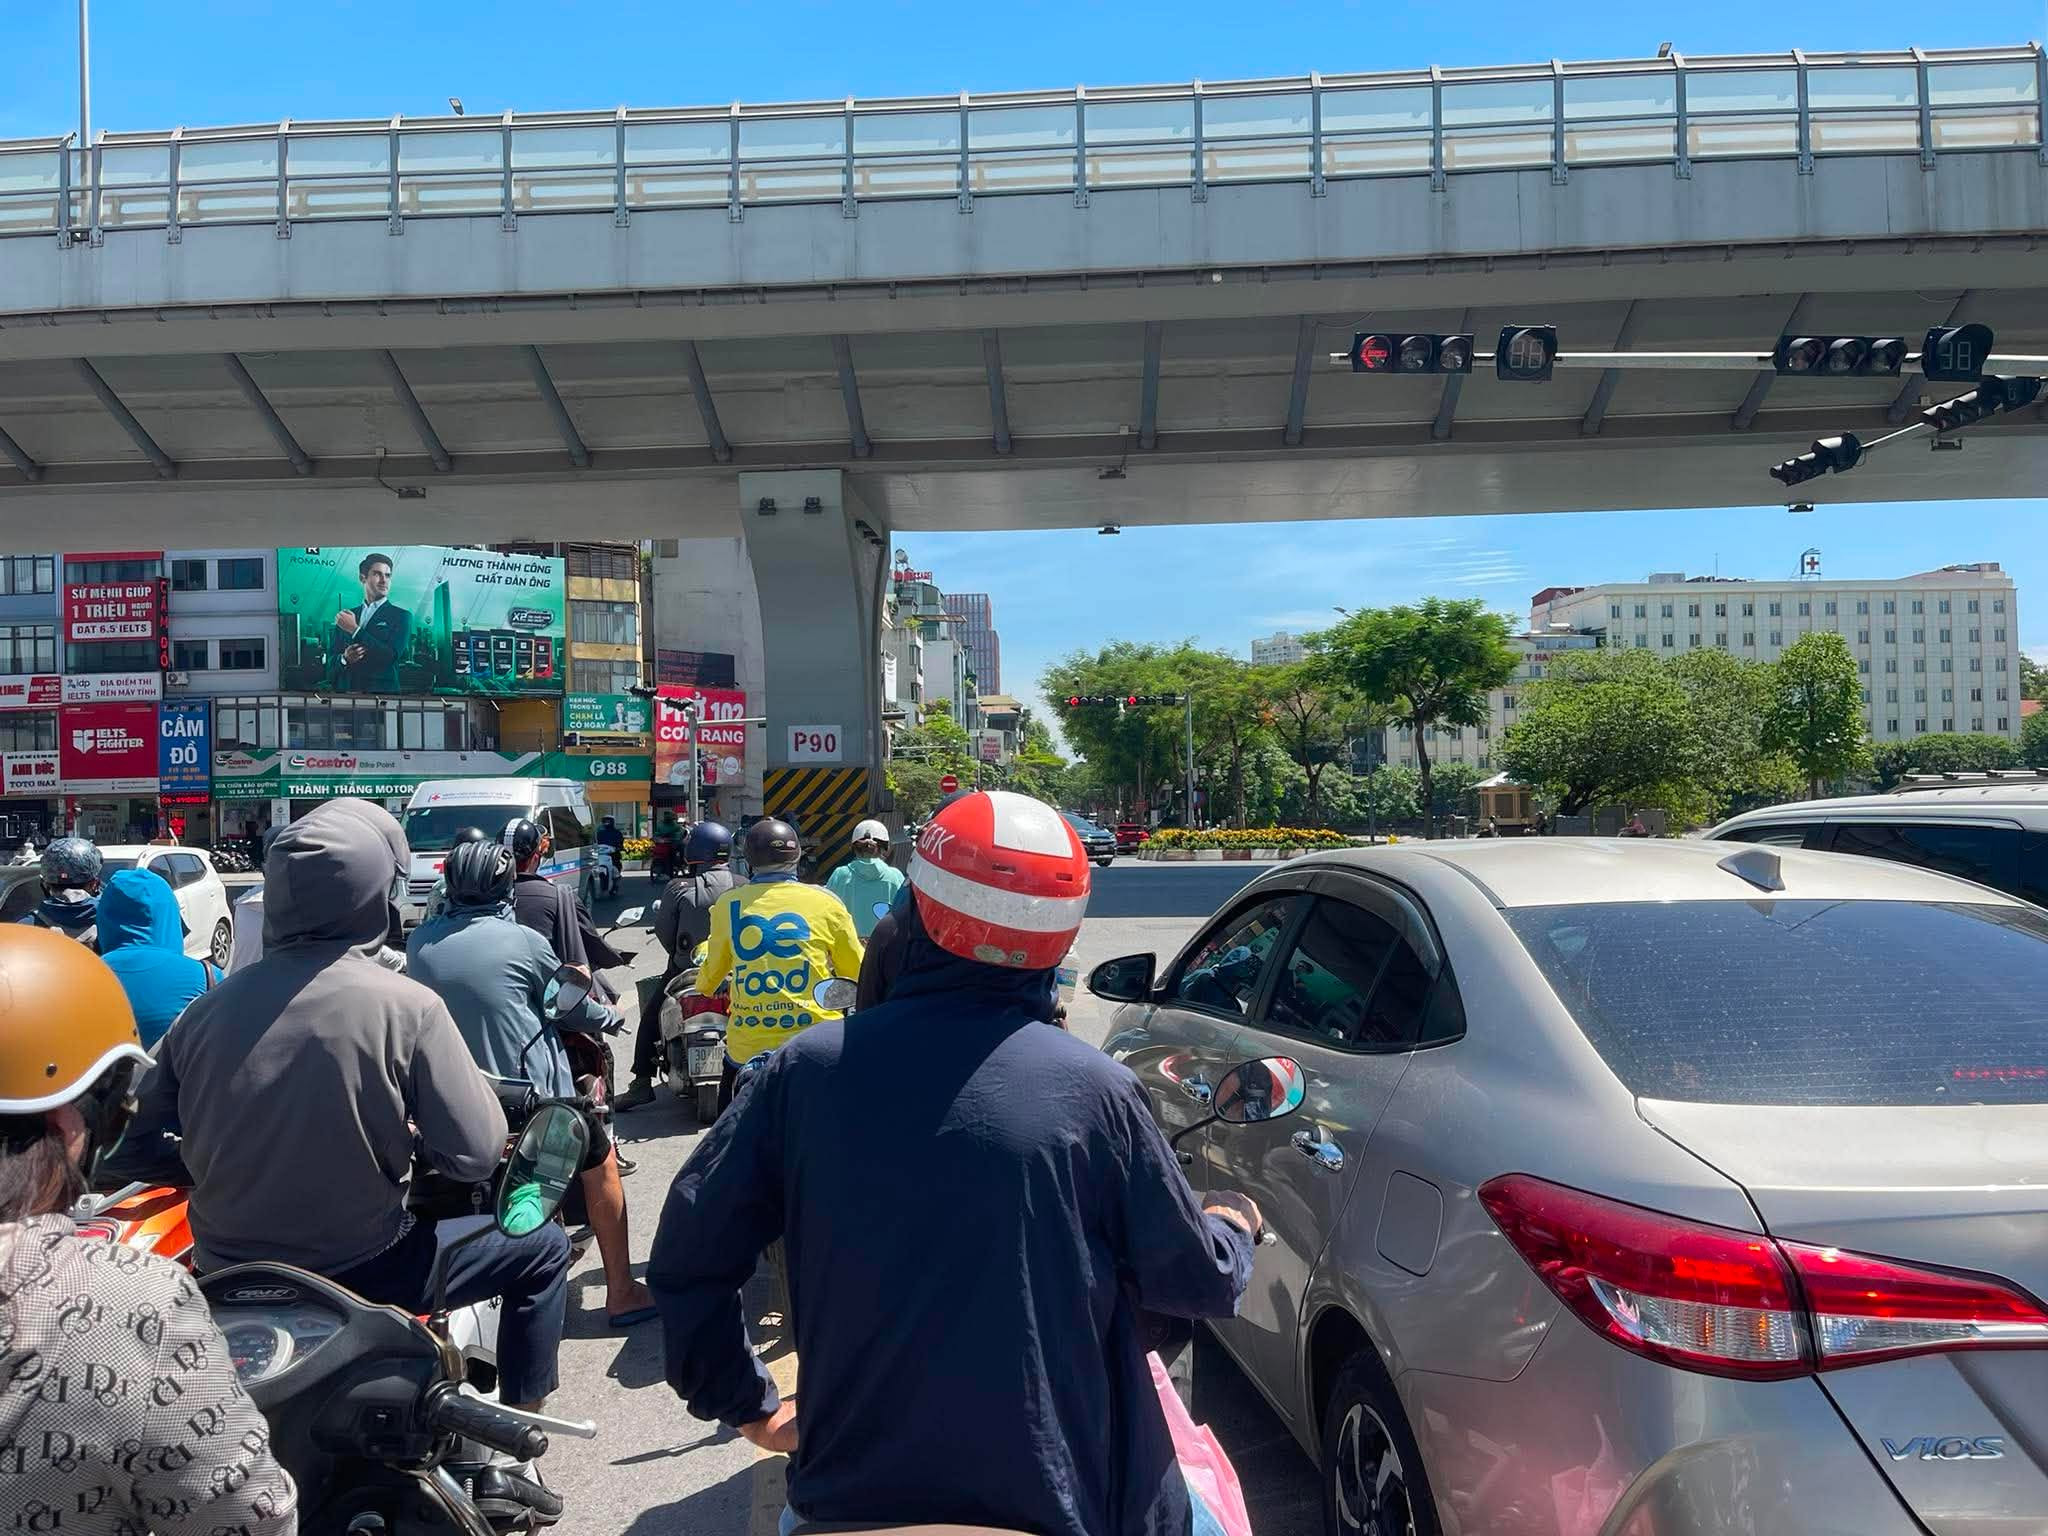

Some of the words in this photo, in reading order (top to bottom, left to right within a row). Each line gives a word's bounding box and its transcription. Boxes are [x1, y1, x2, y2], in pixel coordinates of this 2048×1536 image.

[290, 556, 336, 567] ROMANO
[443, 557, 483, 568] HƯƠNG
[487, 560, 521, 571] THÀNH
[524, 562, 552, 574] CÔNG
[475, 572, 502, 584] CHẤT
[505, 575, 526, 586] ĐÀN
[529, 577, 551, 588] ÔNG
[126, 584, 152, 598] GIÚP
[72, 605, 79, 619] 1
[85, 600, 126, 620] TRIỆU
[100, 624, 116, 634] 6.5
[119, 623, 147, 633] IELTS
[76, 679, 91, 689] idp
[101, 679, 114, 688] ĐỊA
[116, 677, 137, 687] ĐIỂM
[138, 678, 152, 686] THI
[67, 692, 91, 700] IELTS
[96, 688, 117, 697] TRÊN
[118, 687, 137, 697] MÁY
[138, 687, 157, 696] TÍNH
[711, 701, 744, 726] 102
[161, 713, 204, 737] CẦM
[96, 728, 127, 738] IELTS
[701, 728, 744, 743] RANG
[96, 738, 144, 749] FIGHTER
[793, 732, 837, 754] P90
[169, 740, 198, 765] ĐỒ
[306, 757, 357, 769] Castrol
[9, 780, 34, 788] TOTO
[288, 781, 329, 794] THÀNH
[333, 780, 373, 794] THẮNG
[376, 784, 415, 794] MOTOR
[730, 899, 811, 962] be
[735, 960, 810, 997] Food
[766, 1001, 794, 1011] cũng
[1880, 1436, 2005, 1461] VIOS
